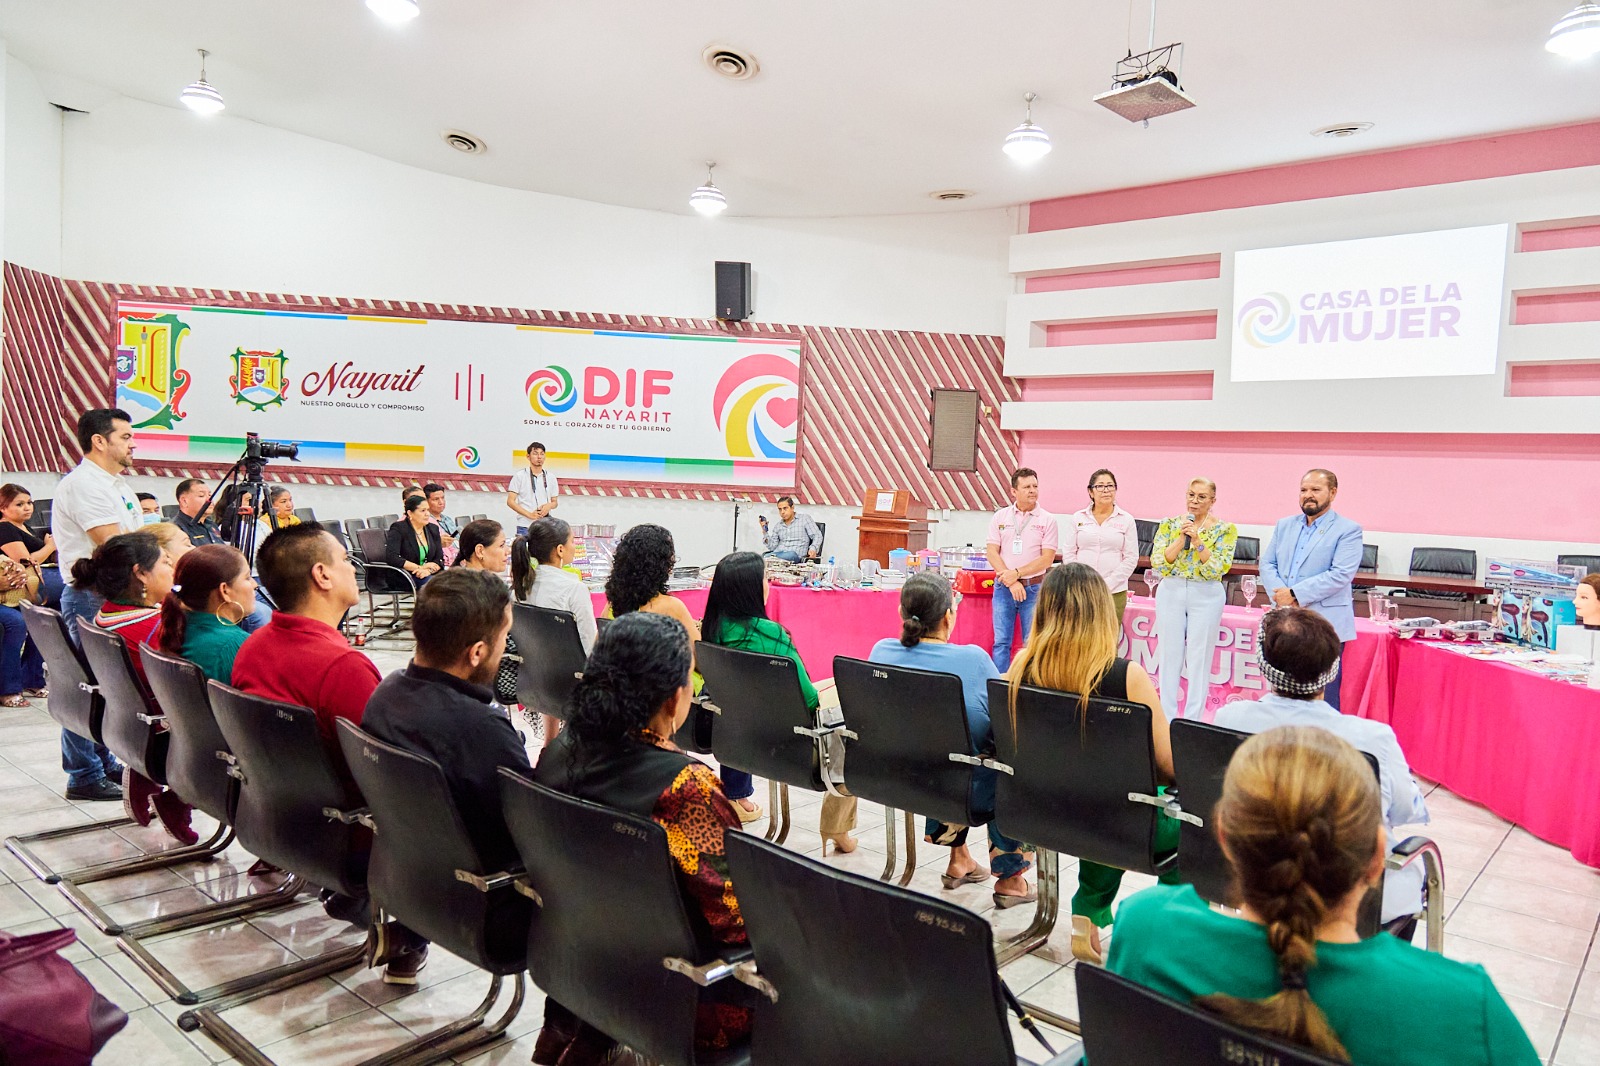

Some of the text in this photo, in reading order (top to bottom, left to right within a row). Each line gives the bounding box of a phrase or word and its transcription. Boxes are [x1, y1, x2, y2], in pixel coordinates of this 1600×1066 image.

[1300, 282, 1463, 311] CASA DE LA
[1298, 305, 1461, 345] MUJER
[301, 361, 425, 399] Nayarit
[583, 366, 674, 408] DIF
[335, 401, 370, 409] ORGULLO
[377, 403, 425, 412] COMPROMISO
[584, 407, 672, 423] NAYARIT
[565, 420, 603, 429] CORAZÓN
[631, 425, 672, 433] GOBIERNO
